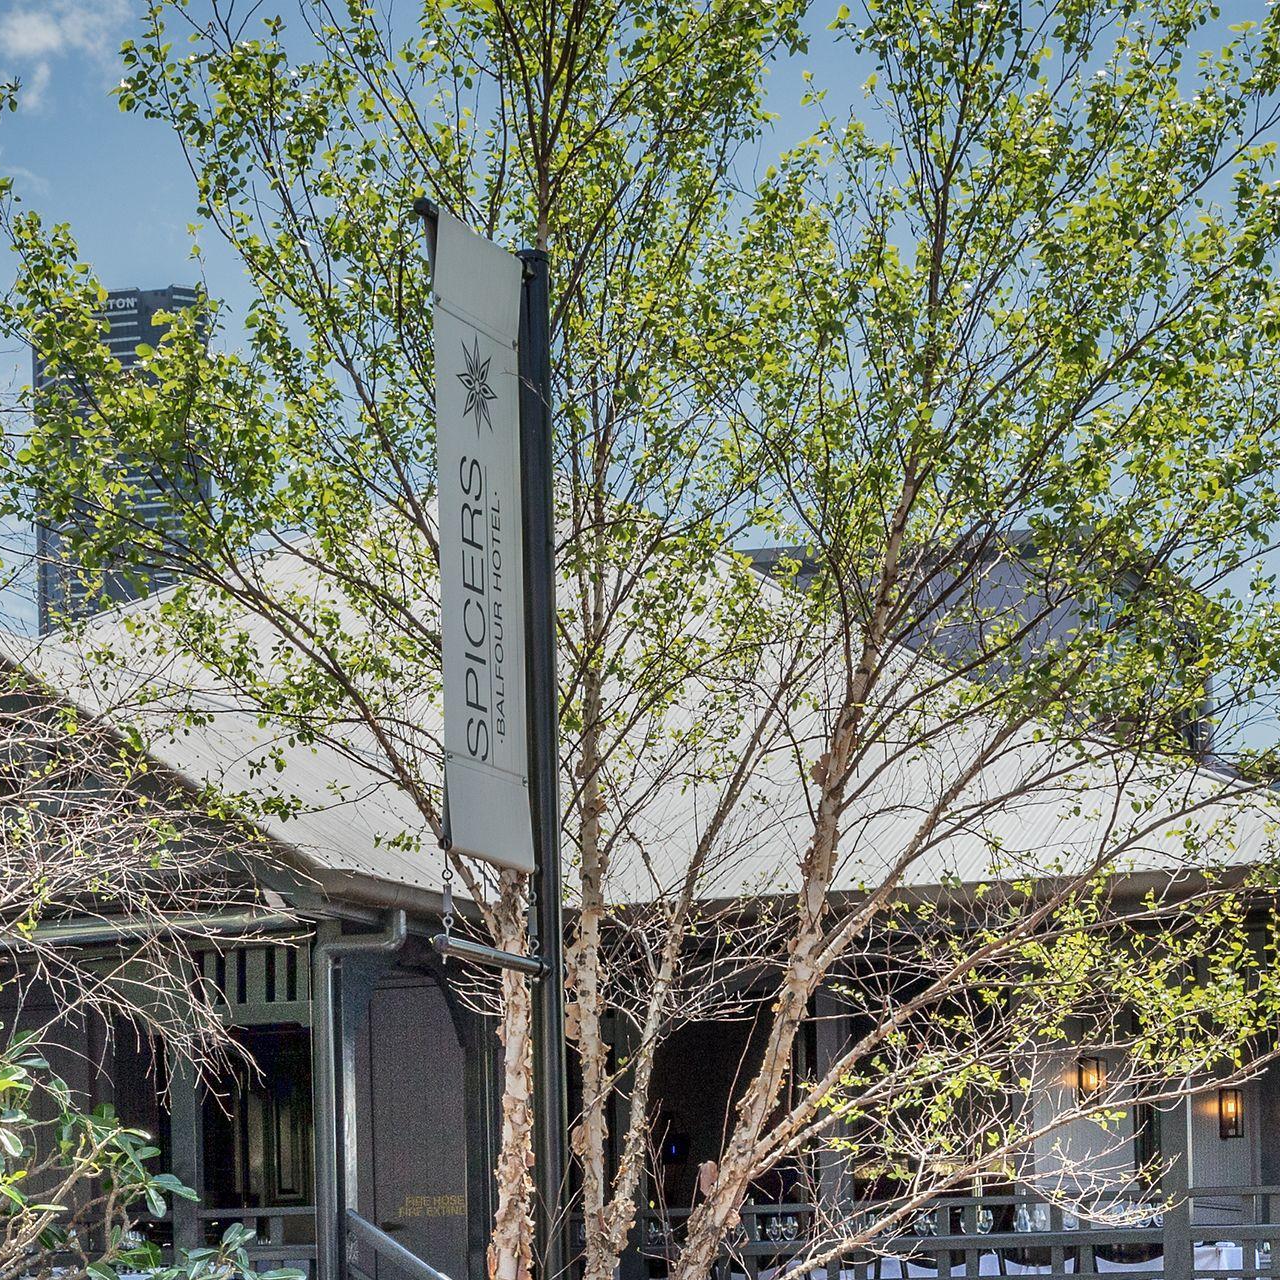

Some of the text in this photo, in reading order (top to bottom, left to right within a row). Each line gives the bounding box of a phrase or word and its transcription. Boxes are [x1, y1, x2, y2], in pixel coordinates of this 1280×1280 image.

[460, 455, 489, 762] SPICERS
[491, 498, 505, 737] BALFOUR HOTEL
